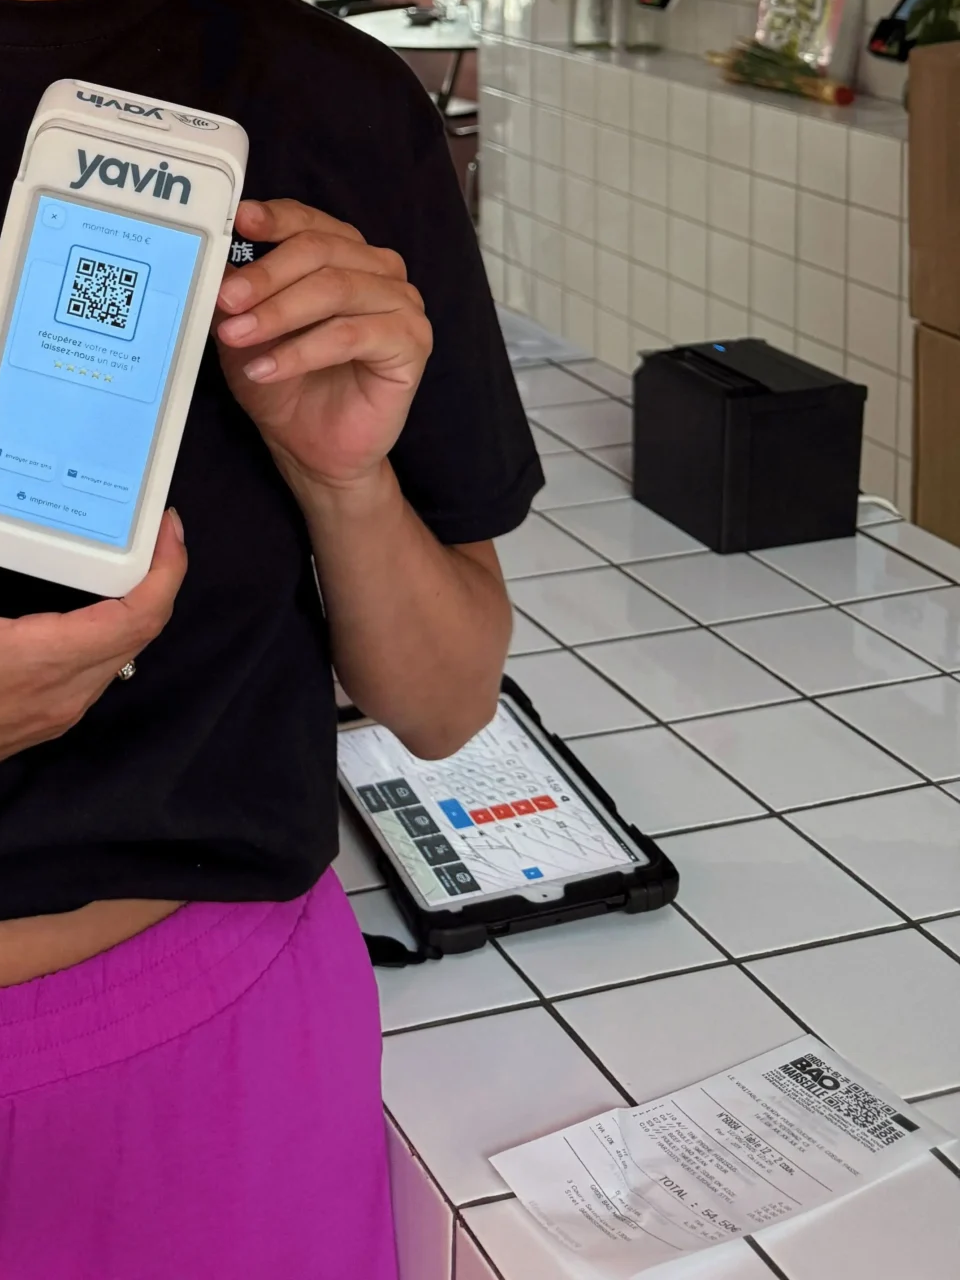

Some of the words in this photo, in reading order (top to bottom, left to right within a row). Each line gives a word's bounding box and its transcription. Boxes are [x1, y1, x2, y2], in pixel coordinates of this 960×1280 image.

[76, 90, 165, 121] yavin
[69, 148, 192, 206] yavin
[231, 241, 254, 262] 族
[37, 329, 83, 348] récupérez
[83, 342, 107, 354] votre
[108, 349, 129, 360] reçu
[130, 354, 141, 363] et
[40, 340, 96, 362] laissez-nous
[96, 357, 108, 365] un
[109, 360, 128, 370] avis
[28, 494, 61, 510] imprimer
[62, 504, 70, 512] le
[70, 507, 87, 518] reçu
[804, 1053, 826, 1068] GROS
[778, 1063, 829, 1099] MARSEILLE
[789, 1057, 841, 1091] BAO
[822, 1065, 852, 1084] 大包子
[595, 1122, 606, 1133] TVA
[867, 1119, 894, 1134] SHARE
[874, 1126, 898, 1140] YOUR
[742, 1133, 764, 1148] Table
[759, 1146, 772, 1154] 12
[881, 1131, 906, 1146] LOVE!
[658, 1175, 690, 1201] TOTAL
[701, 1208, 742, 1233] 54.50€
